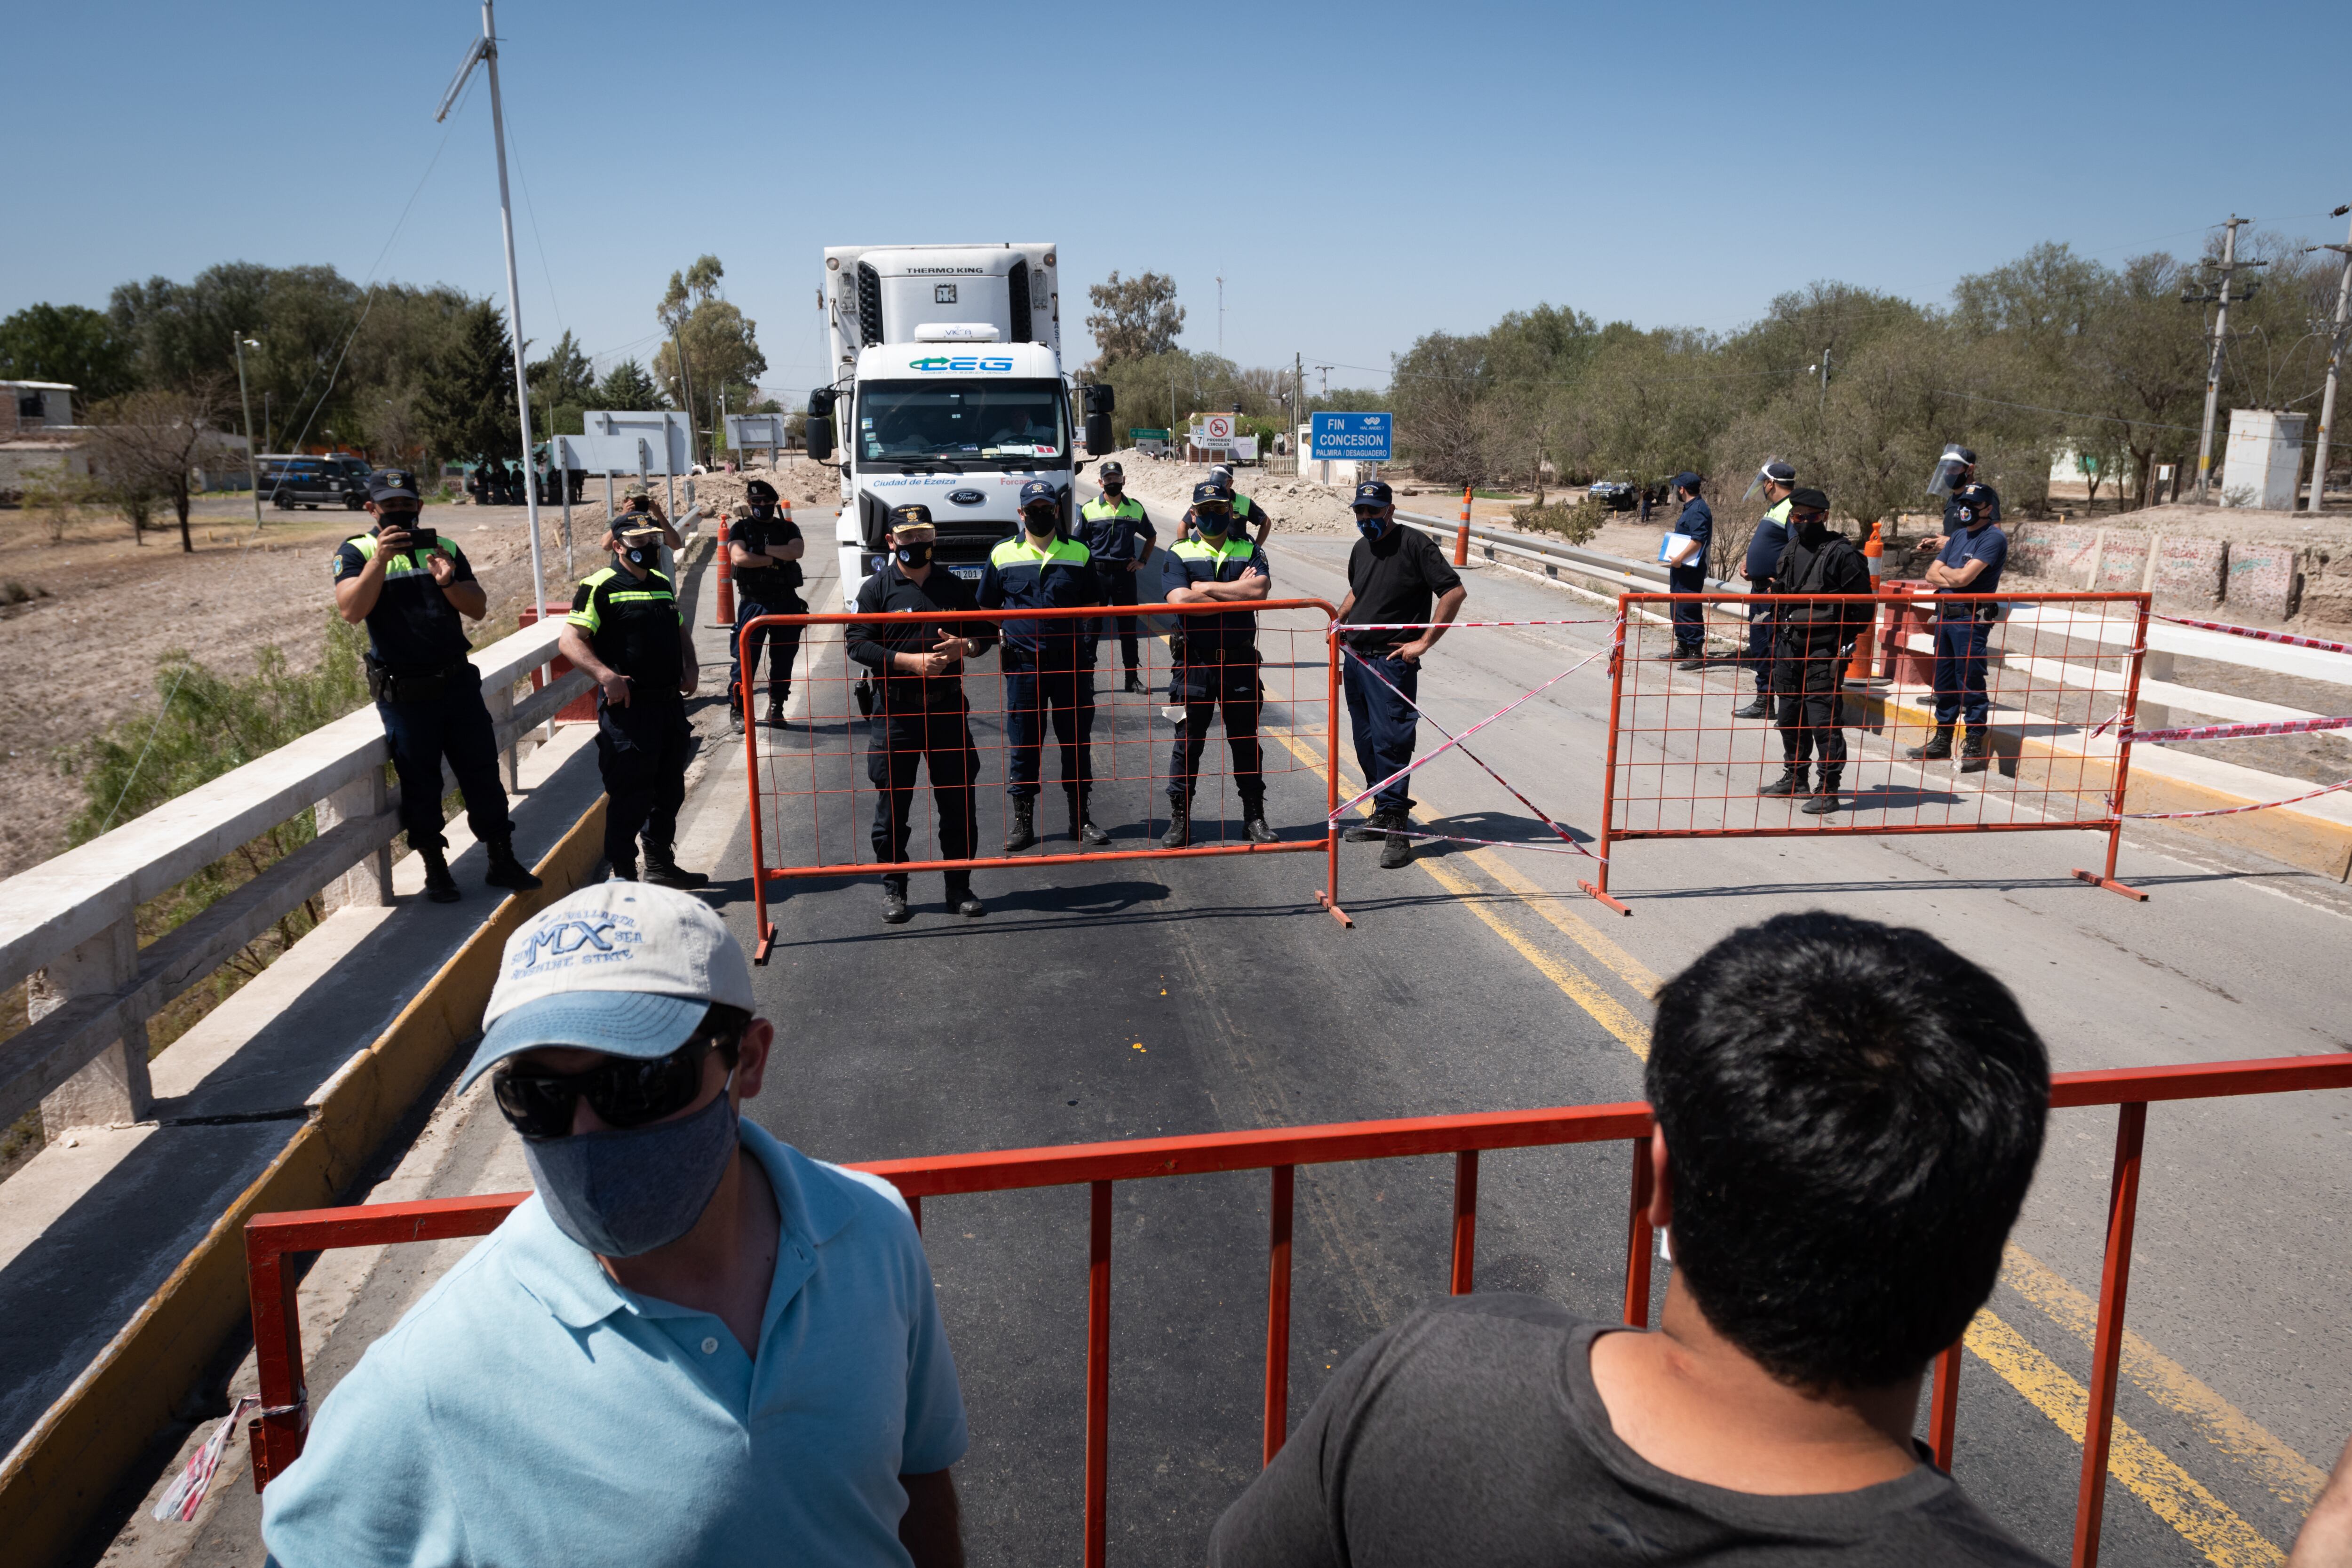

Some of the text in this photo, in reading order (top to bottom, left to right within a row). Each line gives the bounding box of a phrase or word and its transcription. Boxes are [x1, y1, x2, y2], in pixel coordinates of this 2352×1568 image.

[1327, 419, 1344, 430] FIN
[1319, 434, 1383, 446] CONCESION
[873, 478, 907, 487] Ciudad
[956, 492, 977, 502] Ford
[963, 570, 977, 578] 201
[614, 931, 643, 943] SEA
[526, 920, 615, 968] MX
[582, 949, 634, 964] STATE
